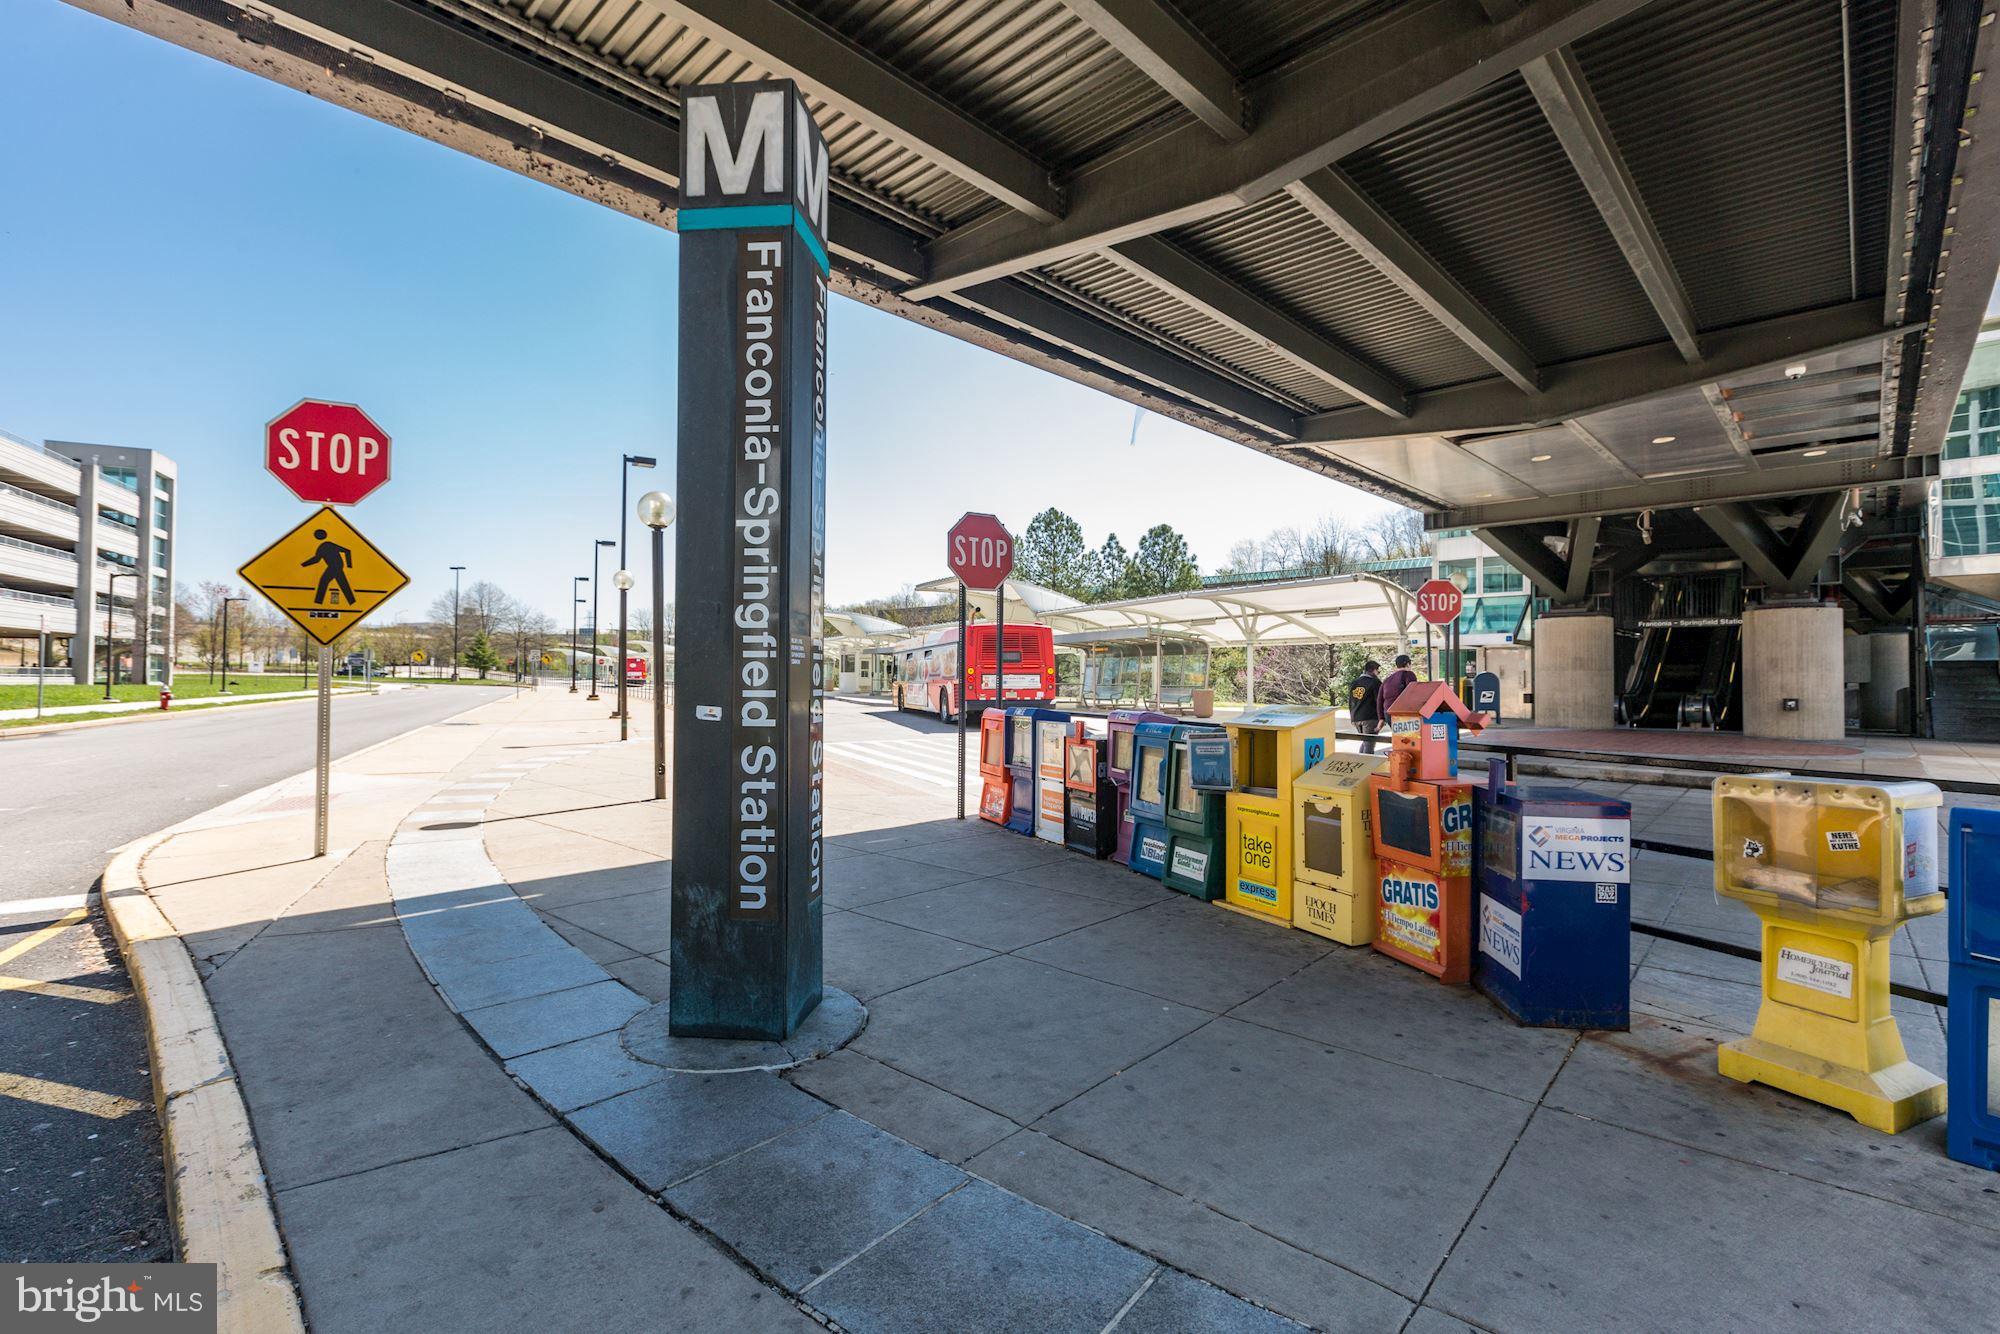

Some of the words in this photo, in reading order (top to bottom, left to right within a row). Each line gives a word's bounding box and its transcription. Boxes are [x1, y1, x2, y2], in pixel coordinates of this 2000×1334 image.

[686, 91, 784, 196] M
[796, 97, 829, 243] M
[277, 427, 380, 476] STOP
[735, 241, 782, 727] Franconia-Springfield
[954, 535, 1008, 568] STOP
[1420, 593, 1459, 611] STOP
[1392, 719, 1420, 733] GRATIS
[740, 745, 777, 910] Station
[810, 739, 823, 893] Station
[1555, 826, 1585, 834] VIRGINIA
[1555, 834, 1624, 843] MEGAPROJECTS
[1243, 834, 1272, 854] take
[1245, 851, 1271, 869] one
[1528, 849, 1625, 872] NEWS
[1240, 881, 1276, 899] express
[1382, 878, 1439, 910] GRATIS
[1305, 895, 1336, 914] EPOCH
[1307, 906, 1335, 924] TIMES
[1391, 912, 1414, 930] Tiempo
[1415, 921, 1437, 938] Latino
[1483, 924, 1520, 966] NEWS
[1810, 964, 1851, 981] Journal
